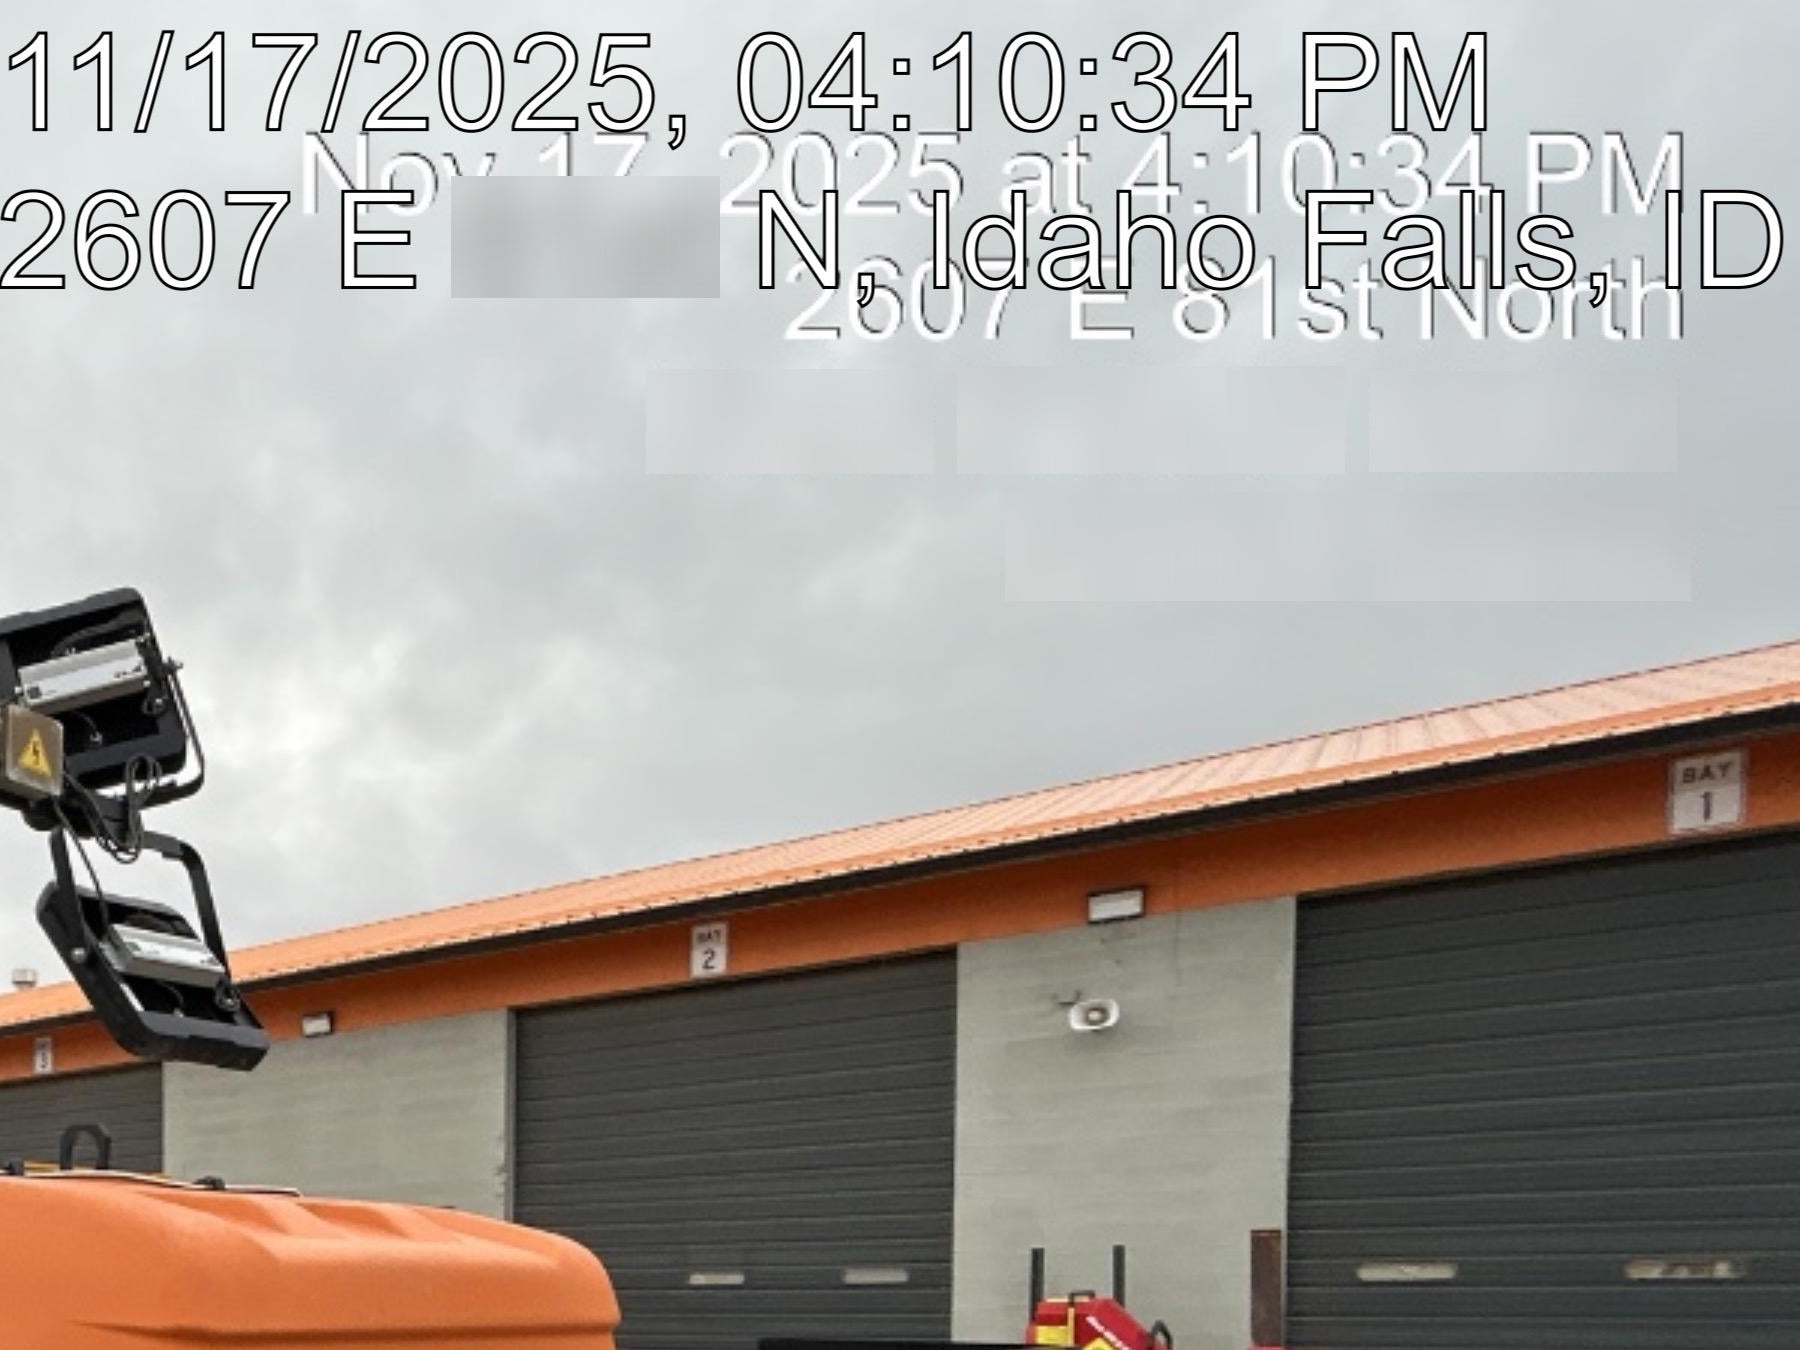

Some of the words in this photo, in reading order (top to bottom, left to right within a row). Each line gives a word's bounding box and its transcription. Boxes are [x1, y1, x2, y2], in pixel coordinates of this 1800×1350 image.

[1681, 761, 1734, 784] BAY
[1701, 791, 1713, 823] 1
[702, 947, 716, 970] 2
